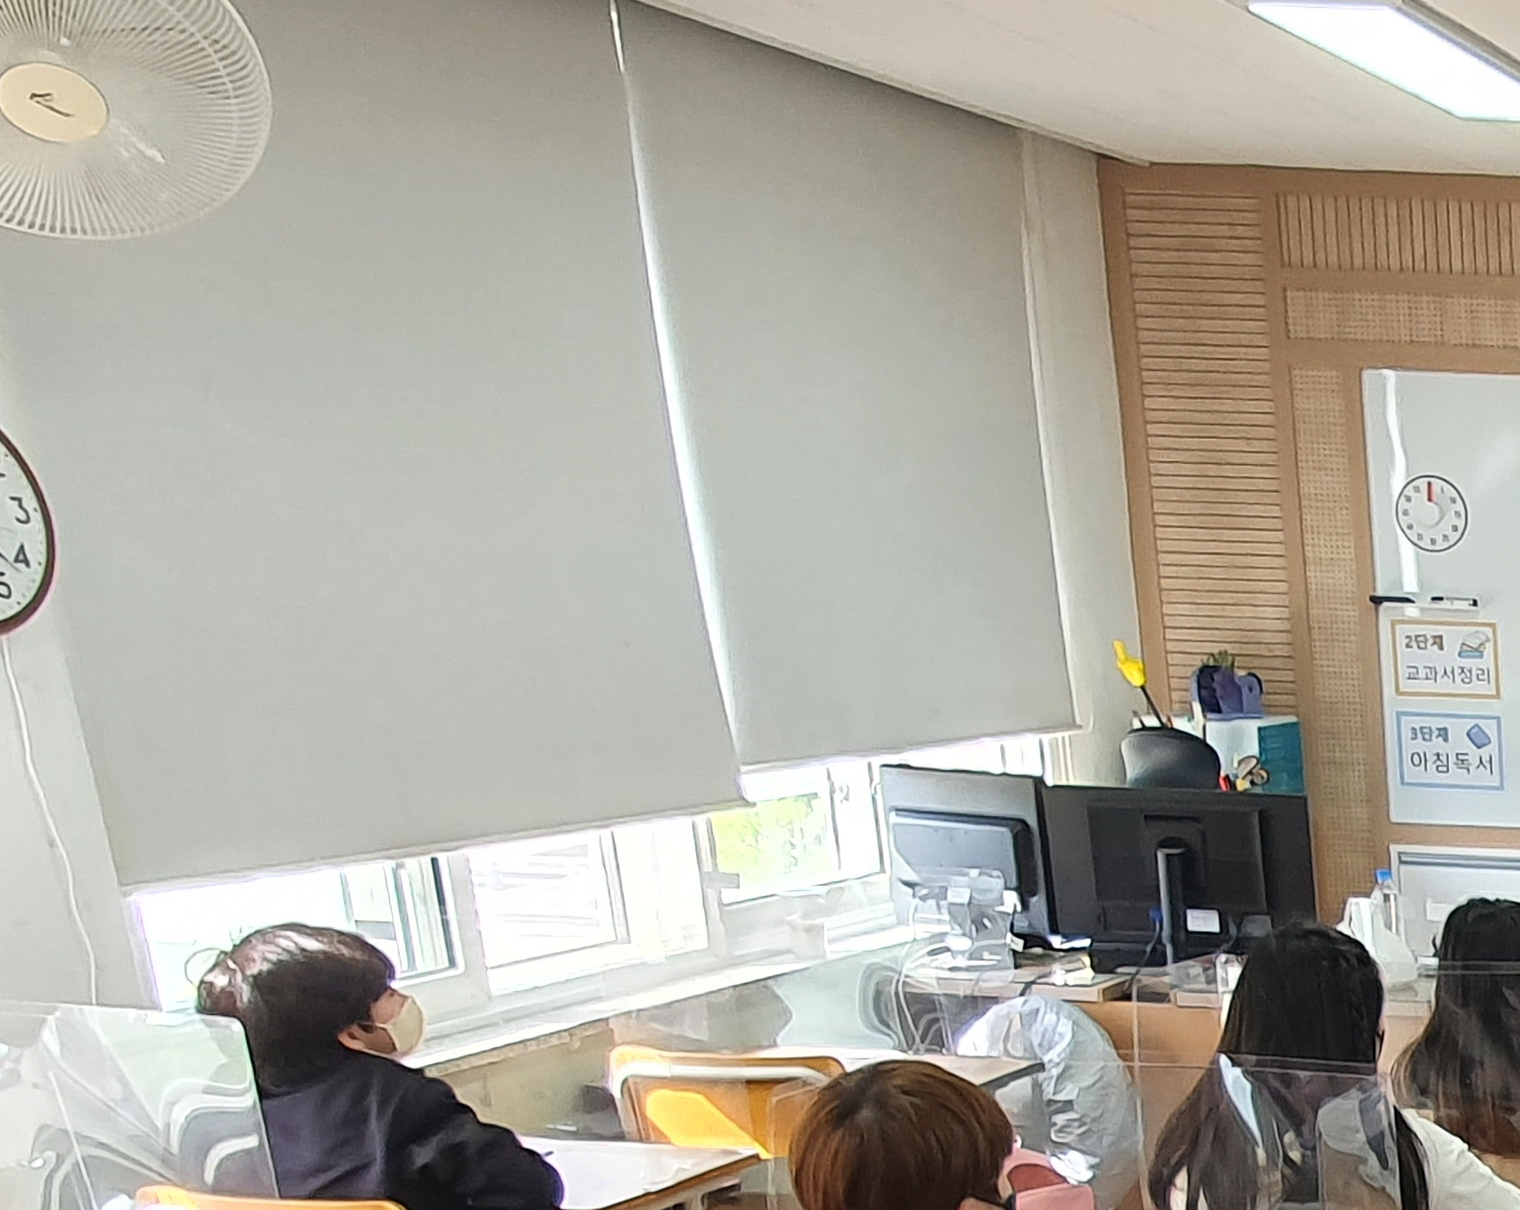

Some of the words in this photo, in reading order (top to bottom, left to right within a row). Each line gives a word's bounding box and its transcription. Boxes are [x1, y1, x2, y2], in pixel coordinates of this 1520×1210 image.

[9, 496, 31, 525] 3
[13, 541, 32, 569] 4
[1406, 664, 1491, 685] 교과서정리
[1410, 751, 1494, 775] 아침독서
